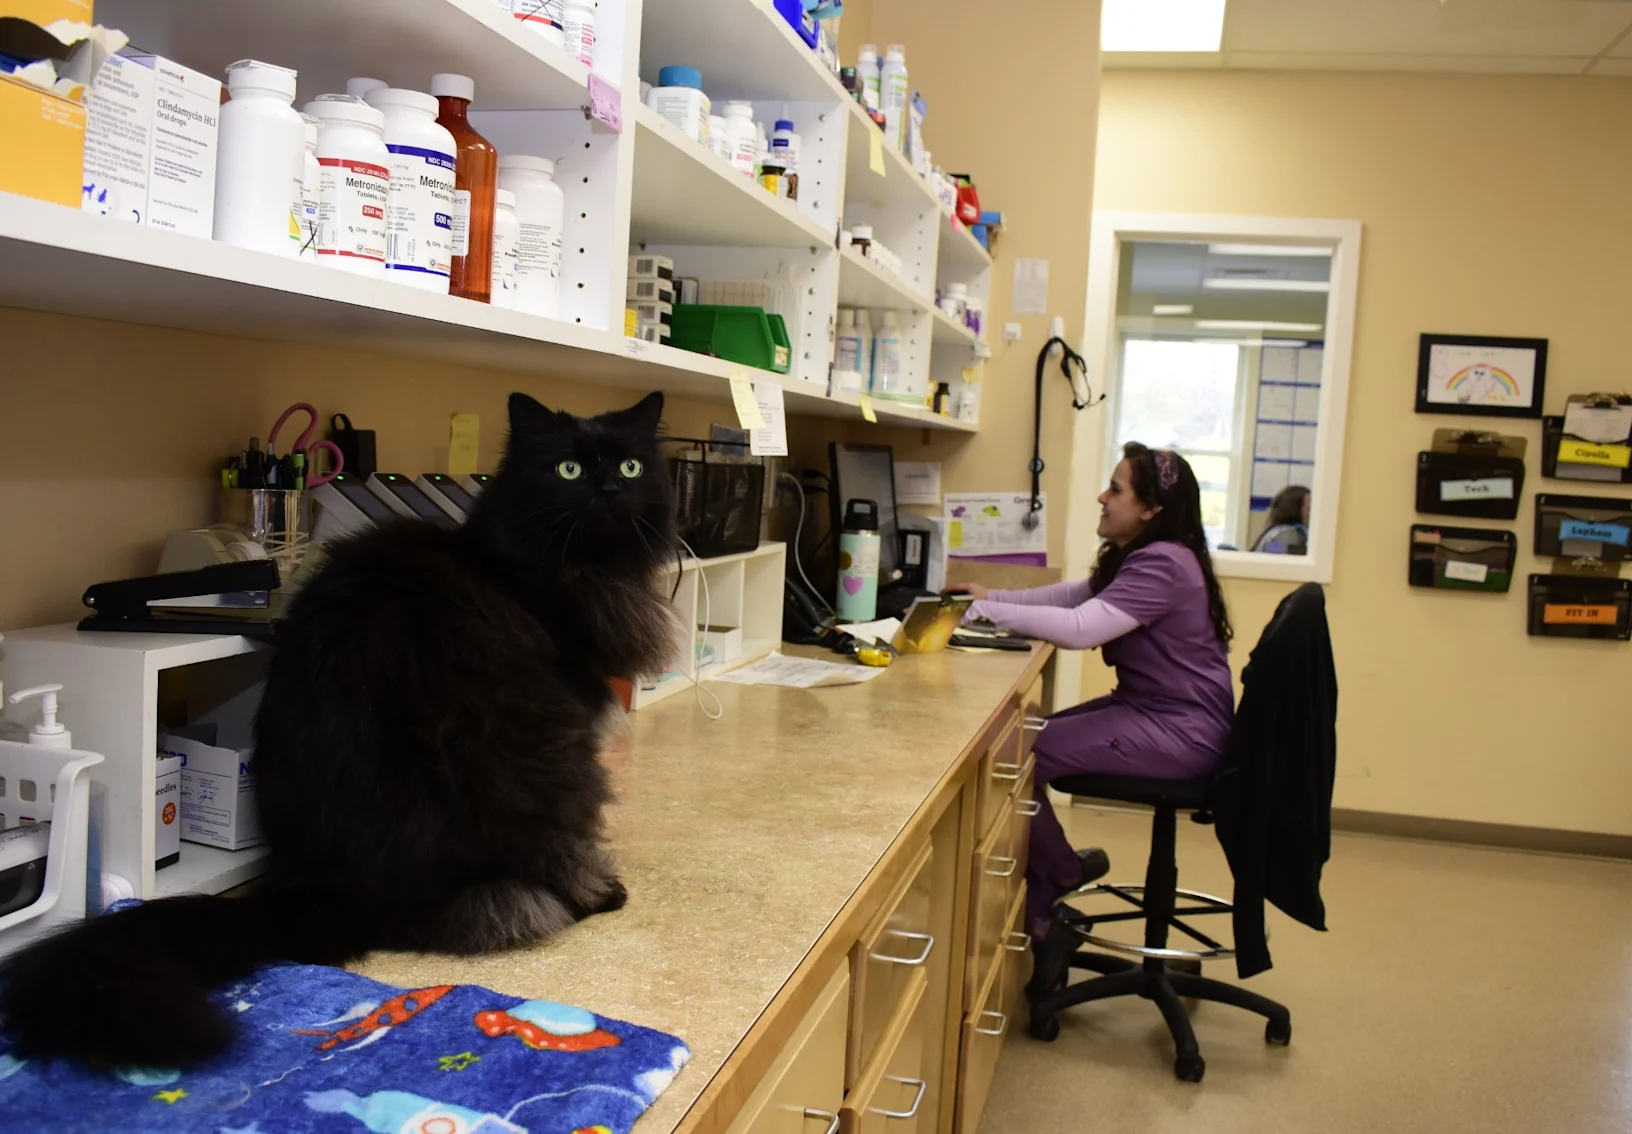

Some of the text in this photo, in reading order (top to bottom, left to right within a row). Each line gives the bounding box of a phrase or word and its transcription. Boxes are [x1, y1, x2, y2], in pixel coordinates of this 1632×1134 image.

[160, 68, 180, 80] covetrus
[157, 98, 216, 127] Clindamycin HCl
[157, 110, 187, 127] Oral drops
[428, 156, 440, 165] NDC
[363, 206, 383, 219] 250 mg
[435, 213, 446, 223] 500
[1575, 448, 1610, 459] Cipolla
[1464, 484, 1490, 493] Tech
[1587, 609, 1600, 617] IN
